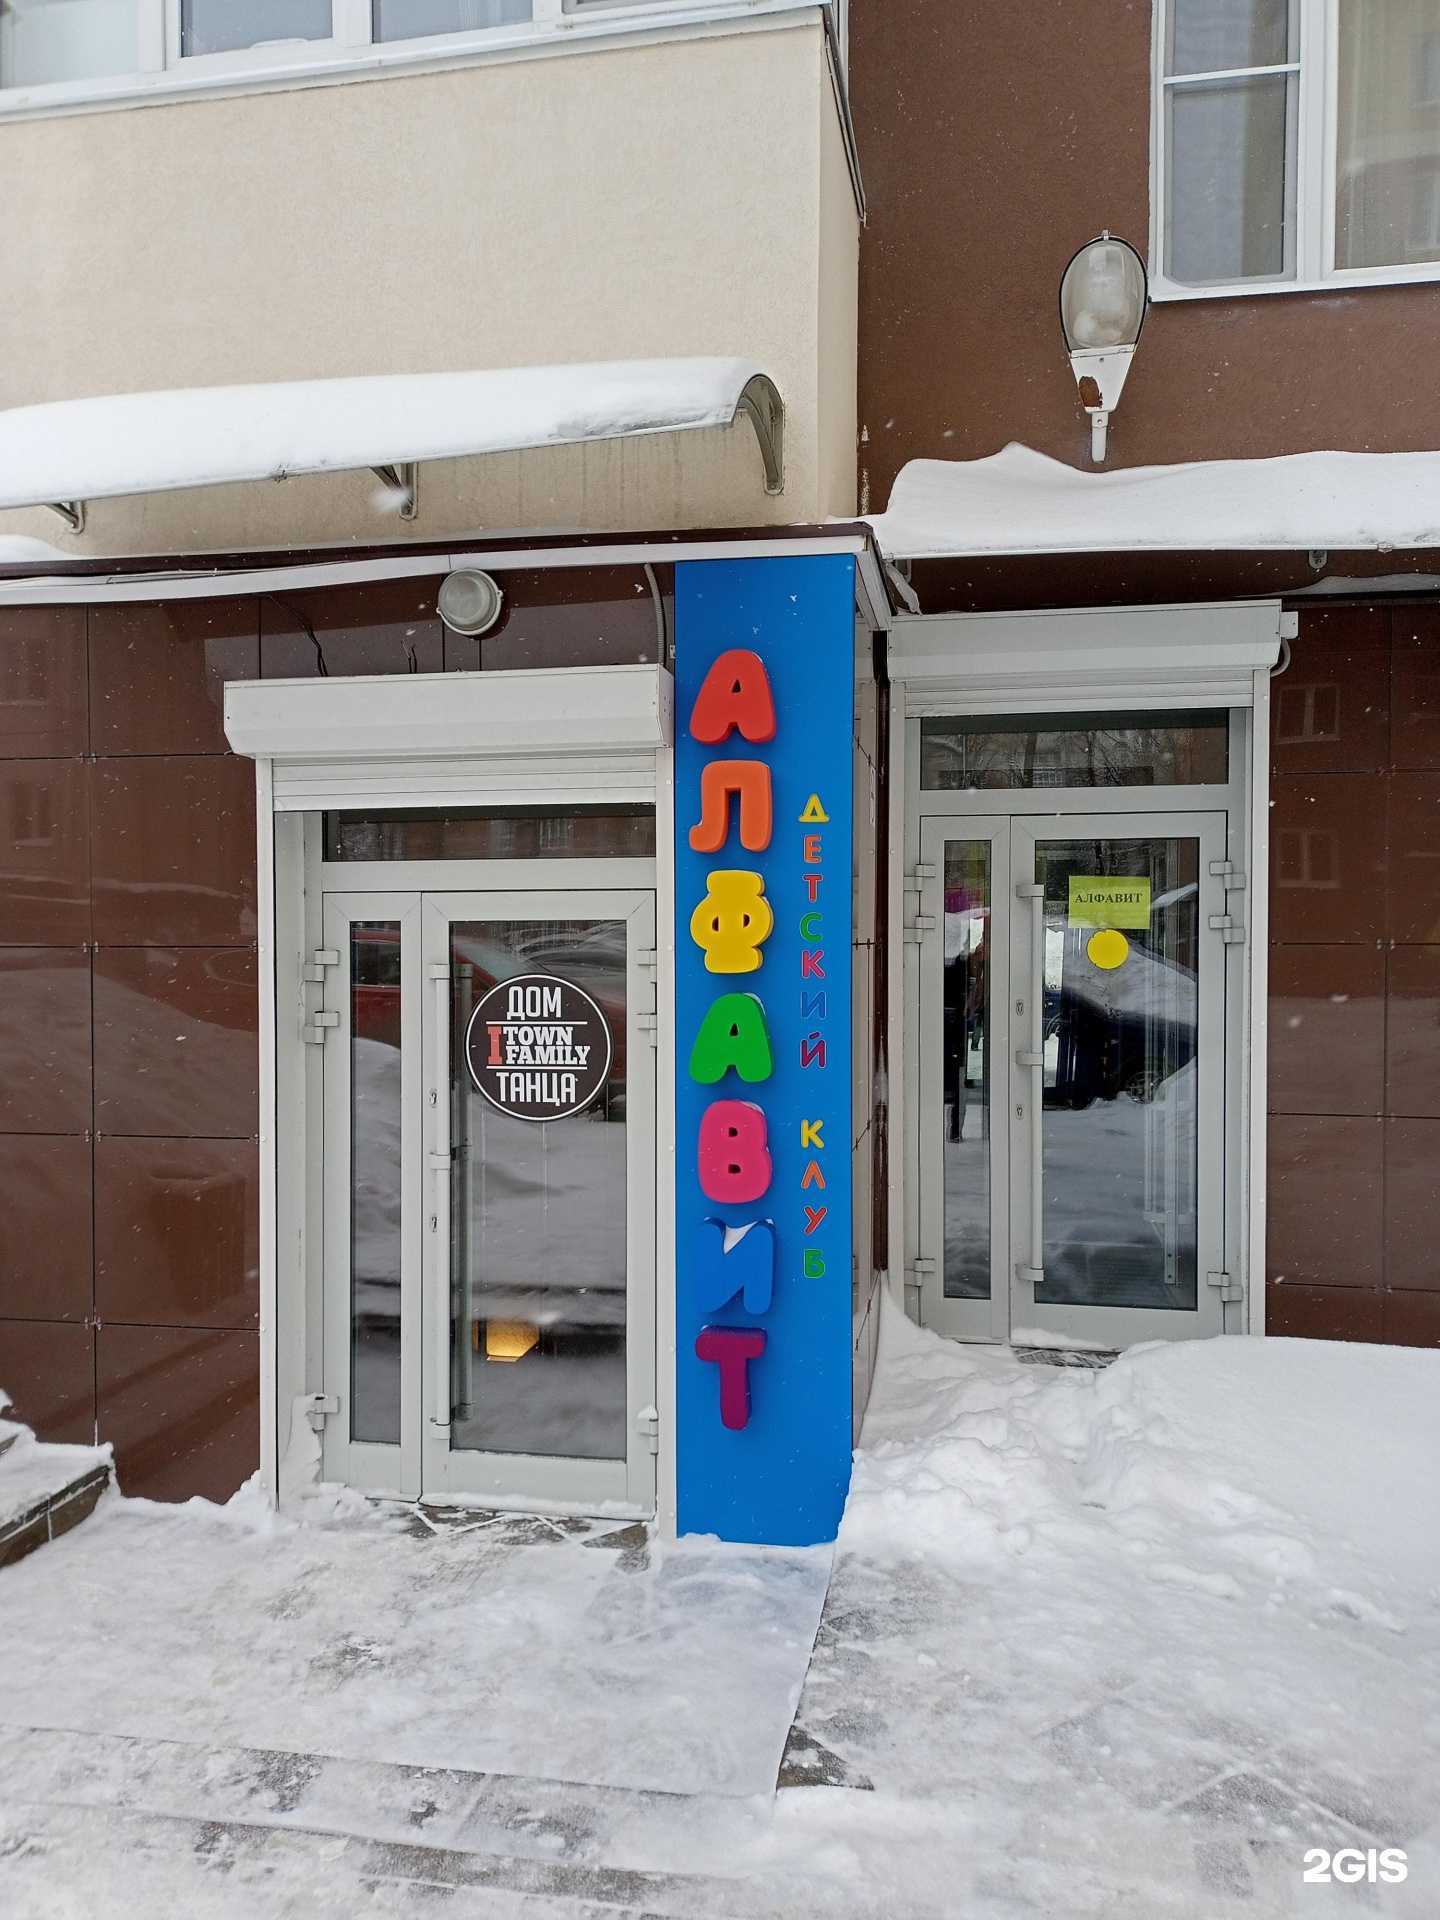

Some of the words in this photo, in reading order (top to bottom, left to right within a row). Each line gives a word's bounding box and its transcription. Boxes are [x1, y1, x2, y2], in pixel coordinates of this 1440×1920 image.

[1074, 892, 1143, 904] АЛФАВИТ
[797, 792, 830, 1069] ДЕТСКИЙ
[506, 985, 562, 1021] ДОМ
[502, 1026, 574, 1046] TOWN
[689, 648, 777, 1431] АЛФАВИТ
[505, 1045, 591, 1065] FAMILY
[495, 1072, 576, 1107] ТАНЦА
[799, 1118, 828, 1279] КЛУБ
